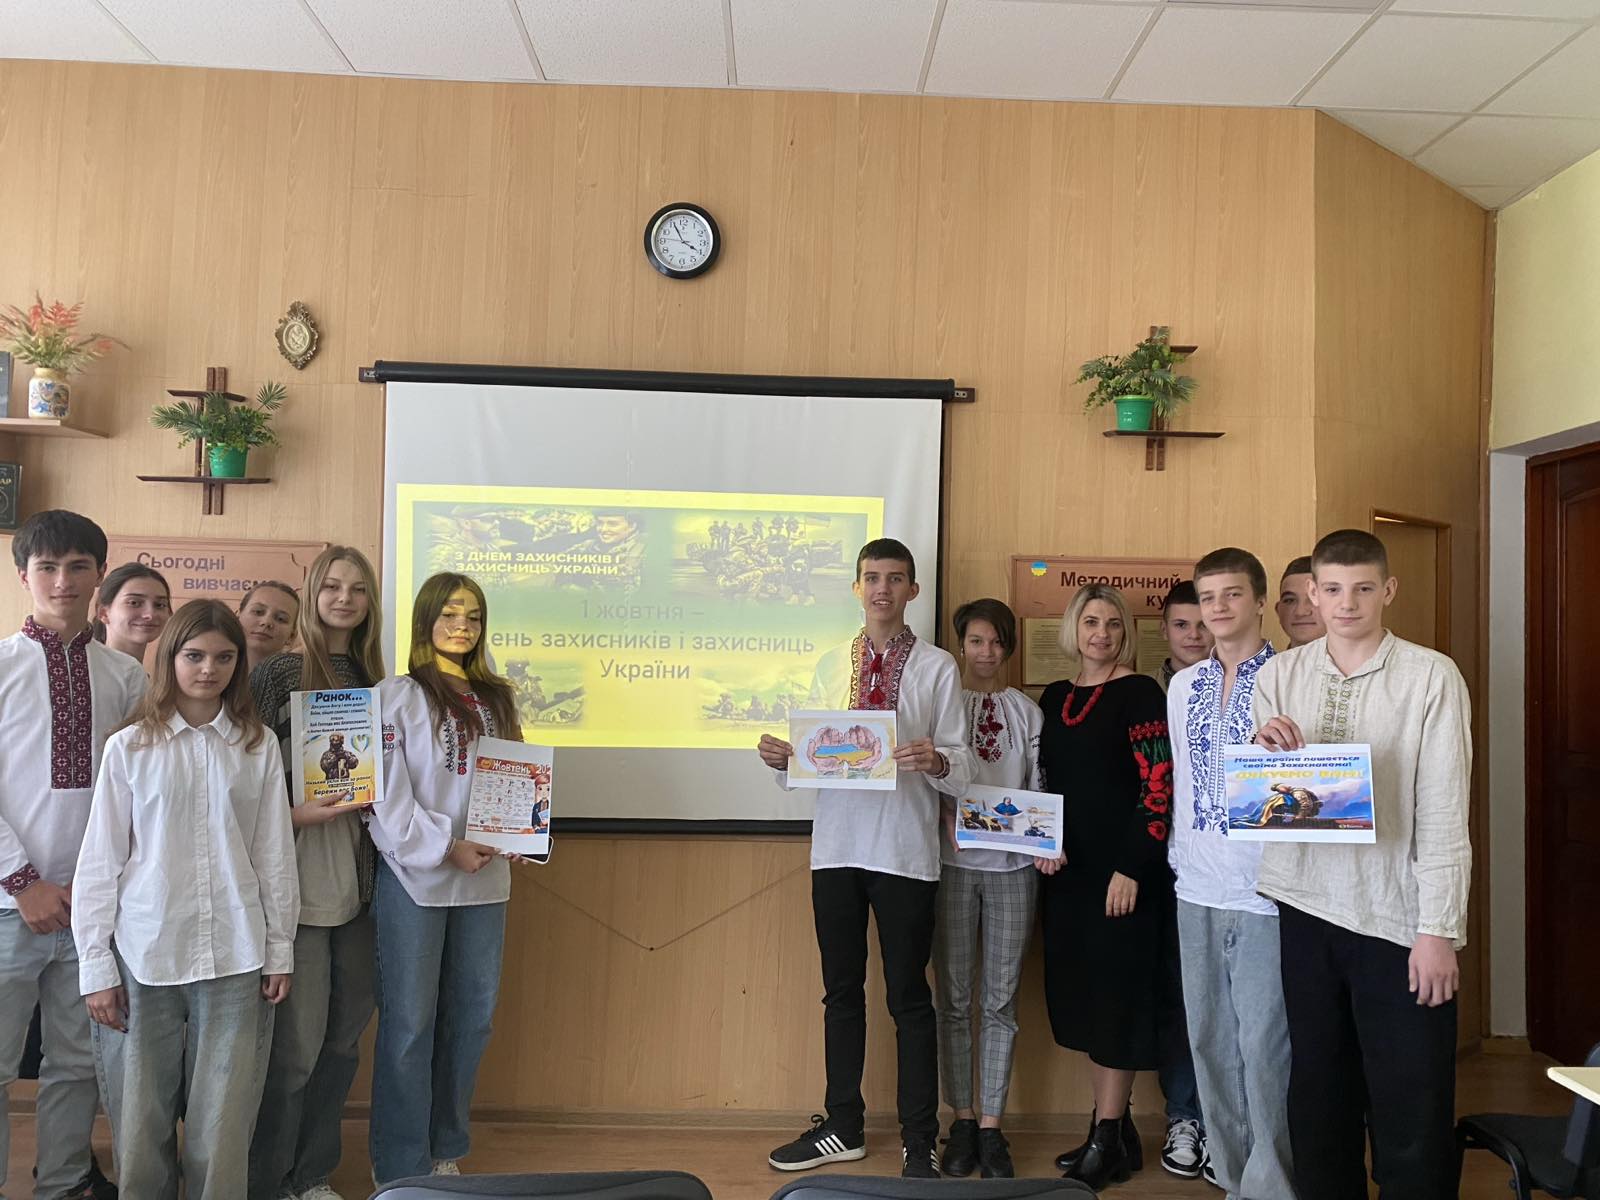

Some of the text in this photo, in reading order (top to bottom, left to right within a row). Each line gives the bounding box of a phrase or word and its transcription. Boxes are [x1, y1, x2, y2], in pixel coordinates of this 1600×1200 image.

[137, 552, 225, 572] Сьогодні
[467, 552, 512, 562] ДНЕМ
[515, 553, 612, 564] ЗАХИСНИКІВ
[455, 563, 619, 575] ЗАХИСНИЦЬ УКРАЇНИ
[1060, 571, 1181, 589] Методичний
[1146, 595, 1168, 610] ку
[597, 603, 683, 620] жовтня
[491, 631, 815, 655] ень захисників і захисниць
[600, 659, 691, 683] України
